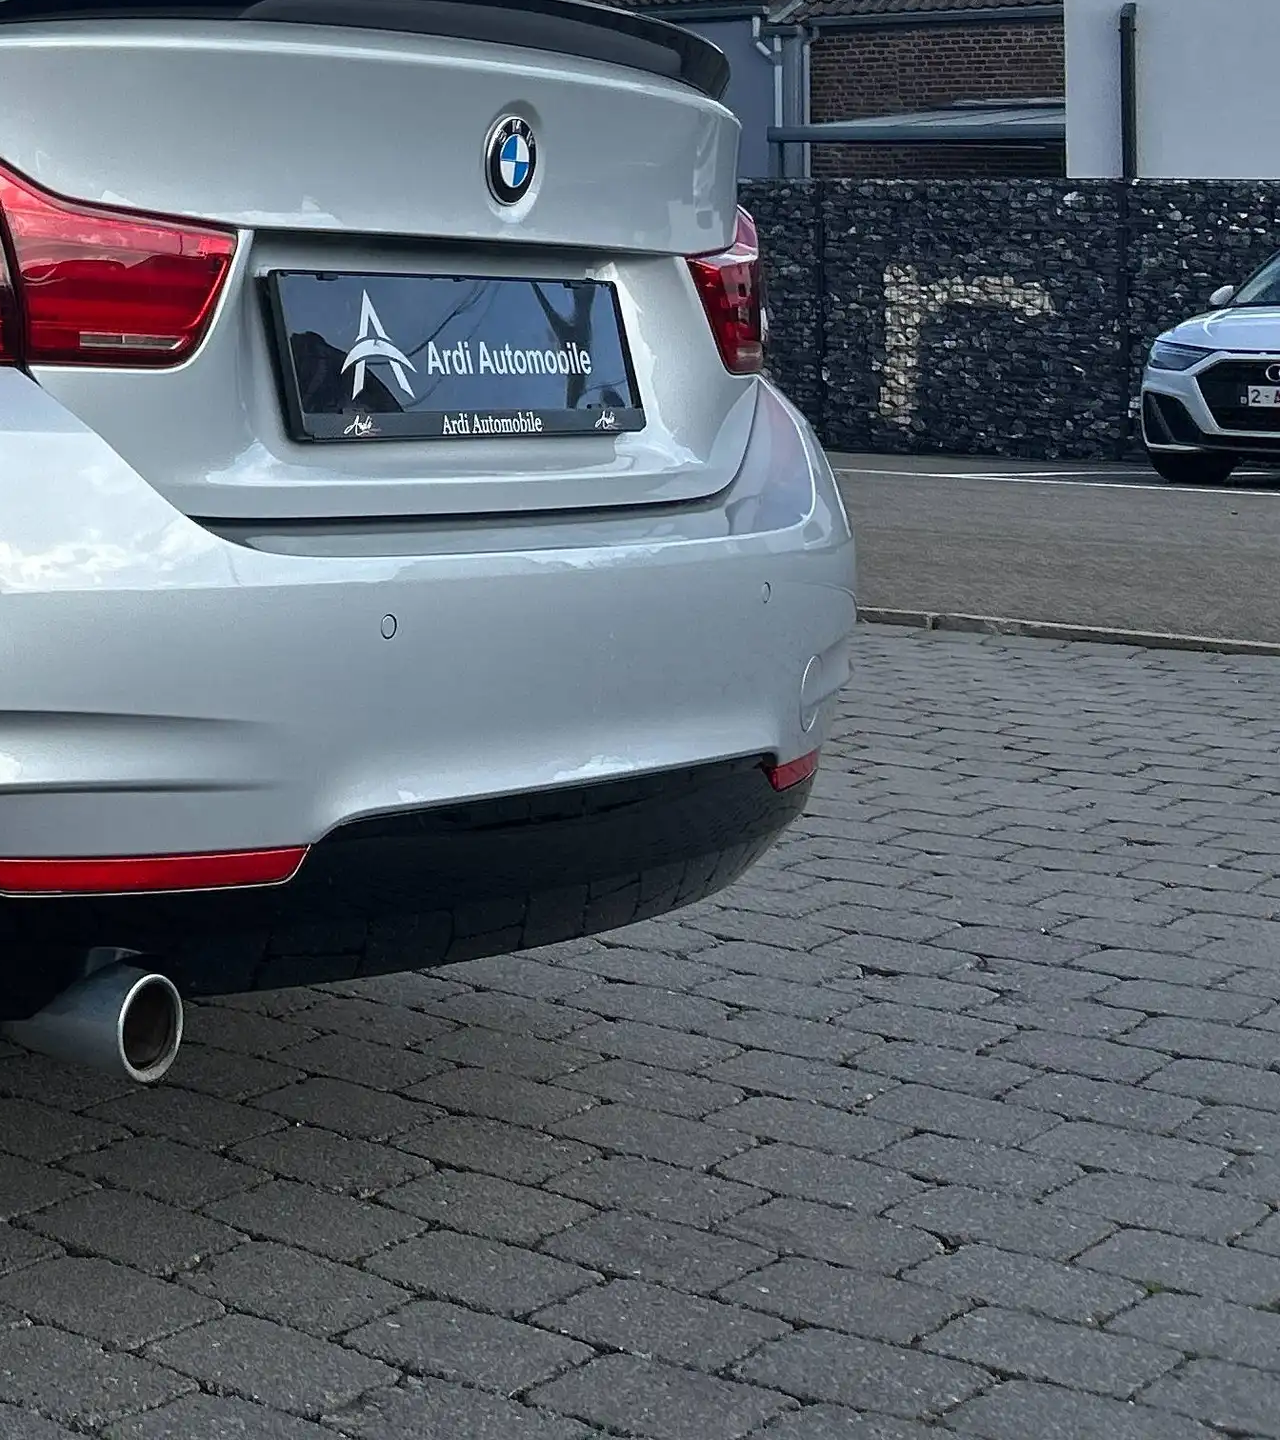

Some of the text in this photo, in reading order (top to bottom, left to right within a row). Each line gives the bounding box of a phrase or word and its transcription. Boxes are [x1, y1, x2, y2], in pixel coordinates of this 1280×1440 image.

[427, 340, 592, 375] Ardi Automobile
[442, 412, 543, 434] Ardi Automobile
